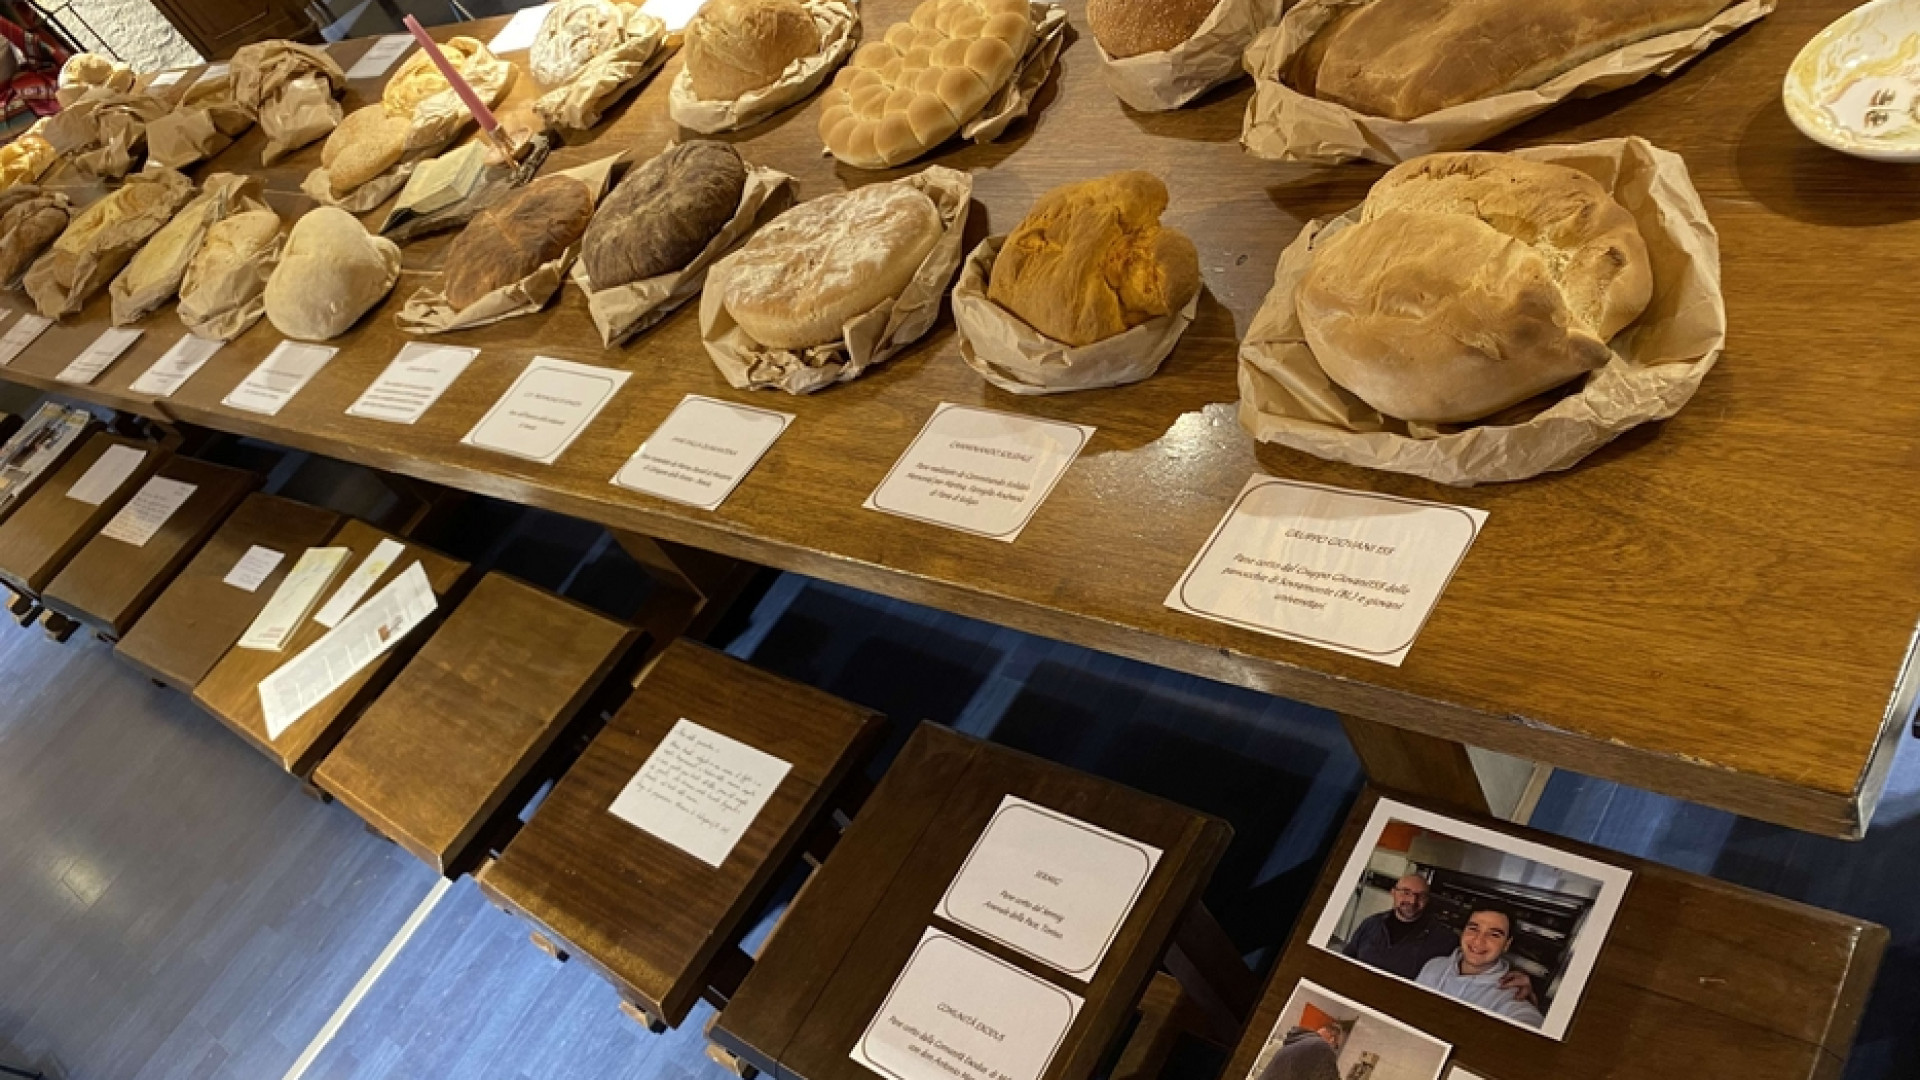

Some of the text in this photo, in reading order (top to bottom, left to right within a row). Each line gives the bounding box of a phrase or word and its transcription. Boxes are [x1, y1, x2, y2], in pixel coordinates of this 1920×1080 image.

[1284, 528, 1329, 543] GRUPPO
[1327, 536, 1377, 551] GIOVANI
[1233, 553, 1255, 564] Pane
[1296, 566, 1332, 580] Gruppo
[1000, 890, 1017, 901] Pane
[888, 1015, 904, 1028] Pane
[974, 1021, 1006, 1041] EXODUS
